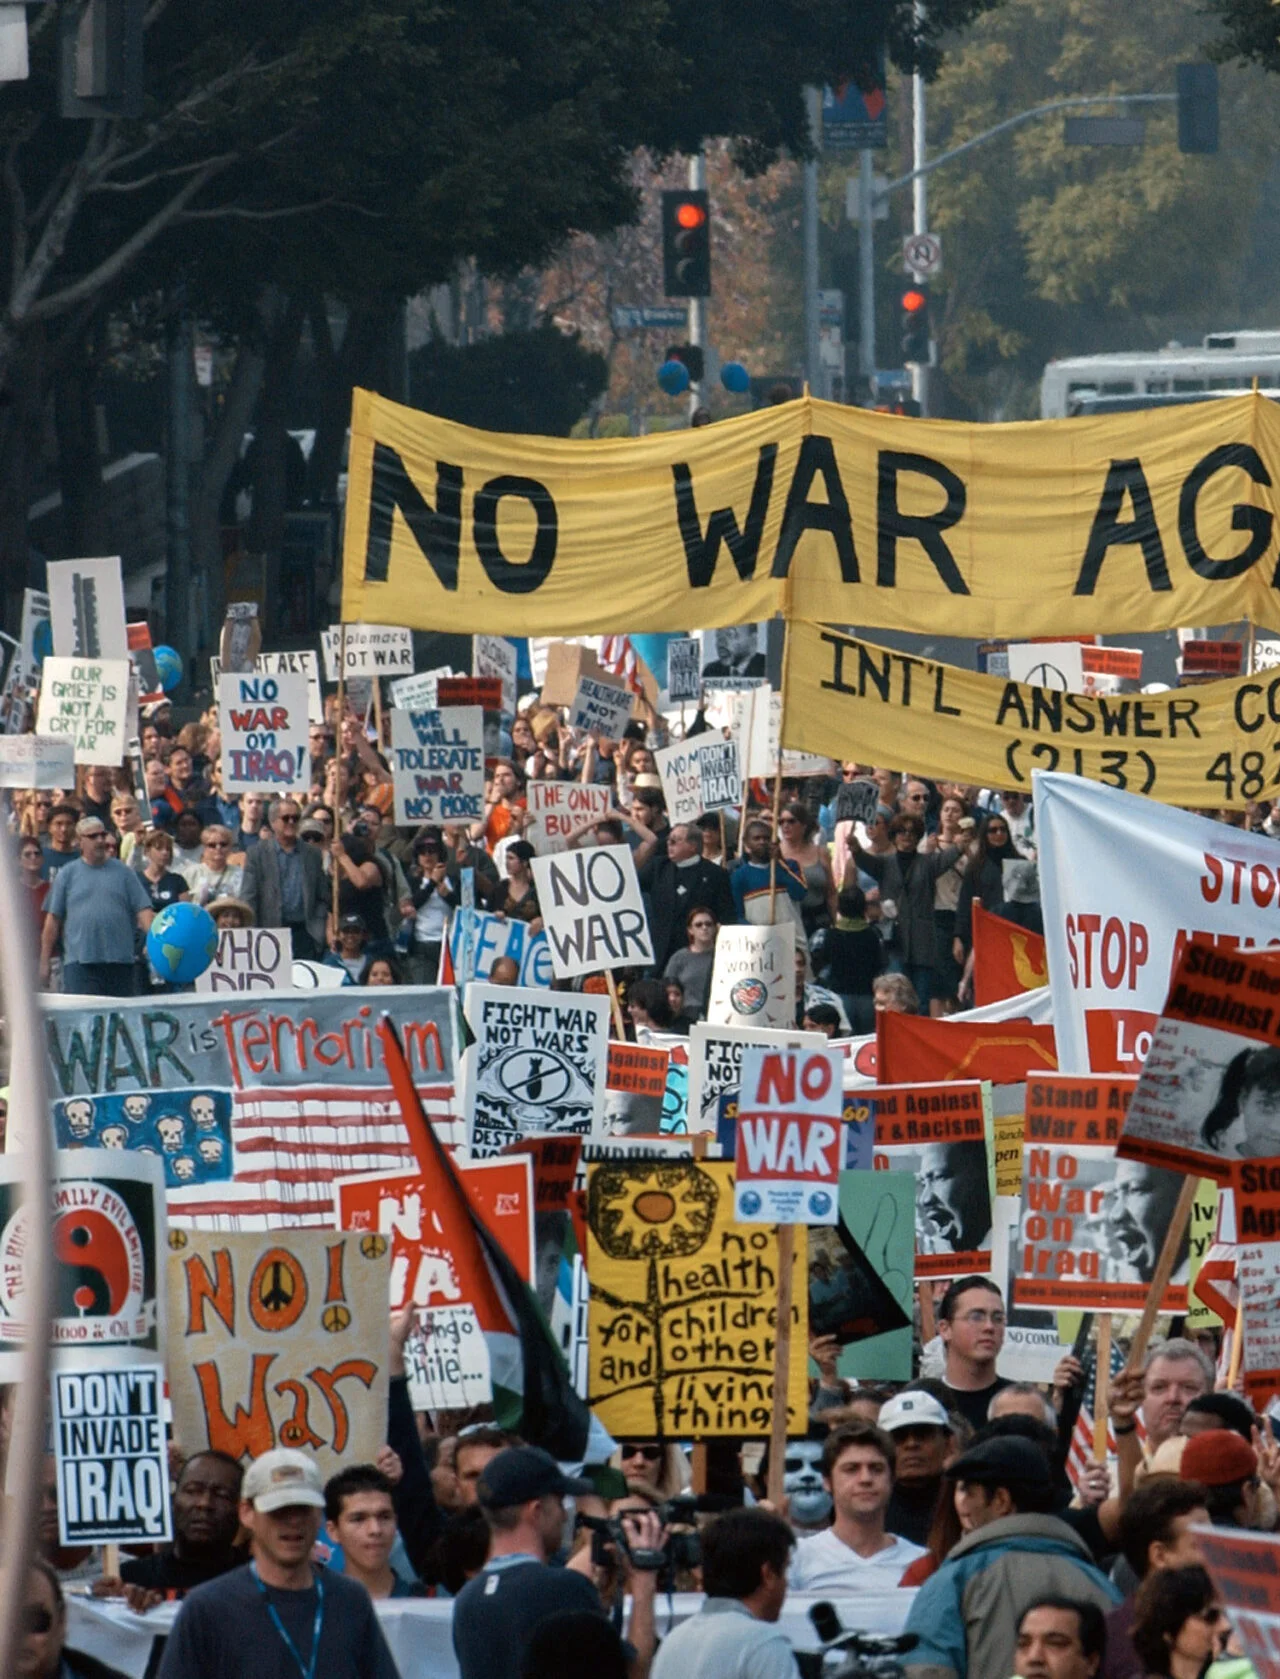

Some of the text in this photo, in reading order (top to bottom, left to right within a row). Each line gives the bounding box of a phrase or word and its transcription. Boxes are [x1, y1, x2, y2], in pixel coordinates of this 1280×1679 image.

[366, 441, 557, 593] NO
[672, 434, 971, 595] WAR
[373, 649, 412, 665] WAR
[71, 666, 102, 680] OUR
[820, 632, 961, 716] INT'L
[996, 683, 1200, 738] ANSWER
[52, 682, 116, 700] GRIEF IS
[239, 678, 279, 701] NO
[579, 678, 633, 710] HEALTHCARE
[60, 701, 105, 718] NOT A
[229, 707, 289, 731] WAR
[409, 710, 443, 729] WE
[587, 702, 617, 719] NOT
[50, 719, 116, 735] CRY FOR
[246, 731, 276, 748] on
[416, 729, 468, 748] WILL
[229, 746, 305, 784] IRAQ!
[396, 746, 482, 771] TOLERATE
[701, 743, 736, 762] DON'T
[666, 760, 687, 778] NO
[701, 760, 737, 777] INVADE
[415, 774, 464, 794] WAR
[532, 783, 609, 813] THE ONLY
[704, 775, 740, 802] IRAQ
[404, 797, 482, 819] NO MORE
[551, 852, 626, 907] NO
[549, 909, 650, 967] WAR
[1066, 913, 1149, 990] STOP
[1184, 945, 1247, 986] Stop
[483, 1001, 598, 1034] FIGHT WAR
[1169, 983, 1274, 1035] Against
[46, 1012, 218, 1095] WAR is
[485, 1025, 589, 1053] NOT WARS
[756, 1053, 833, 1105] NO
[904, 1091, 980, 1117] Against
[1031, 1084, 1097, 1110] Stand
[908, 1116, 983, 1142] Racism
[1029, 1115, 1077, 1139] War
[741, 1117, 836, 1177] WAR
[1029, 1148, 1077, 1180] No
[1027, 1183, 1104, 1215] War
[1025, 1216, 1074, 1242] on
[1023, 1244, 1099, 1279] Iraq
[184, 1239, 347, 1337] NO!
[598, 1313, 650, 1347] for
[600, 1346, 652, 1386] and
[58, 1372, 156, 1418] DON'T
[194, 1352, 379, 1462] War
[61, 1419, 159, 1456] INVADE
[65, 1458, 164, 1533] IRAQ
